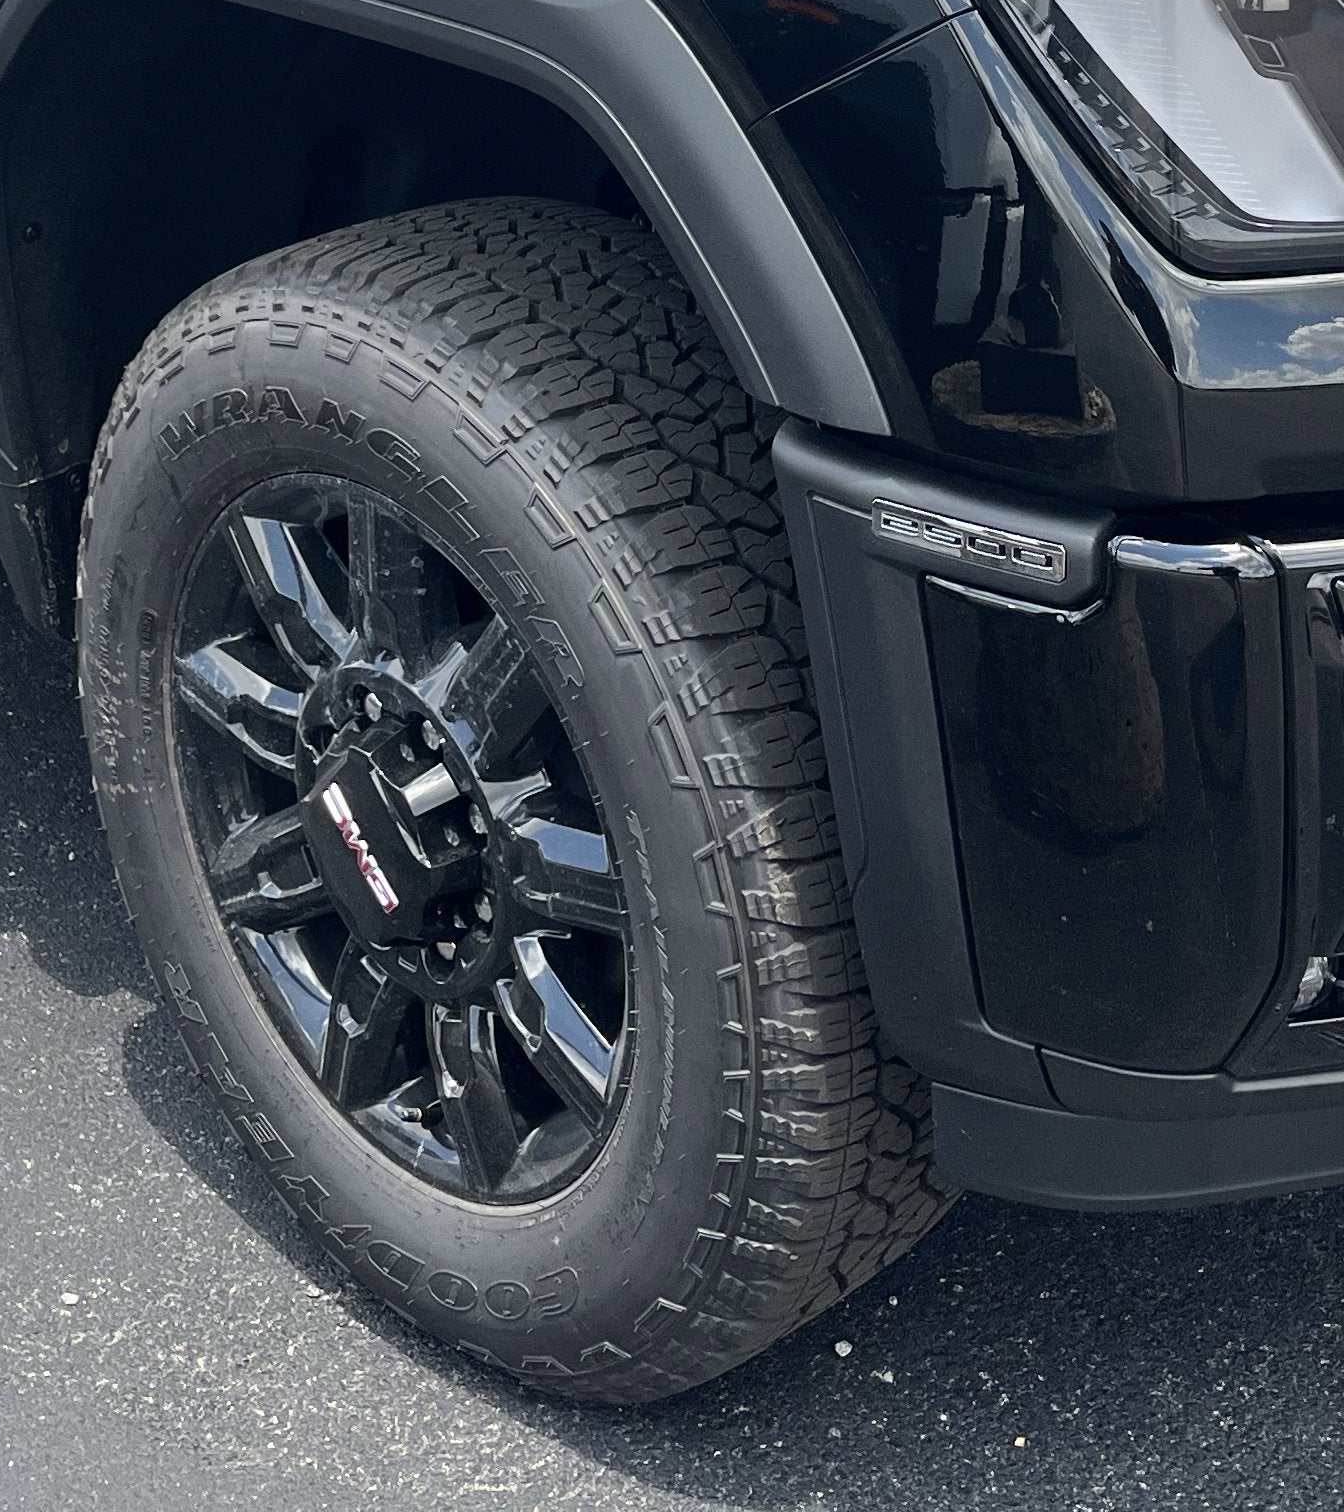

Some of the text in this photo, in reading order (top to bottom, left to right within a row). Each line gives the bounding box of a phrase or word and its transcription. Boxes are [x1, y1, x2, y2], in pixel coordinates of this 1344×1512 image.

[158, 384, 586, 689] WRANGLER
[879, 510, 1056, 572] 2500
[163, 960, 581, 1322] GOODYEAR
